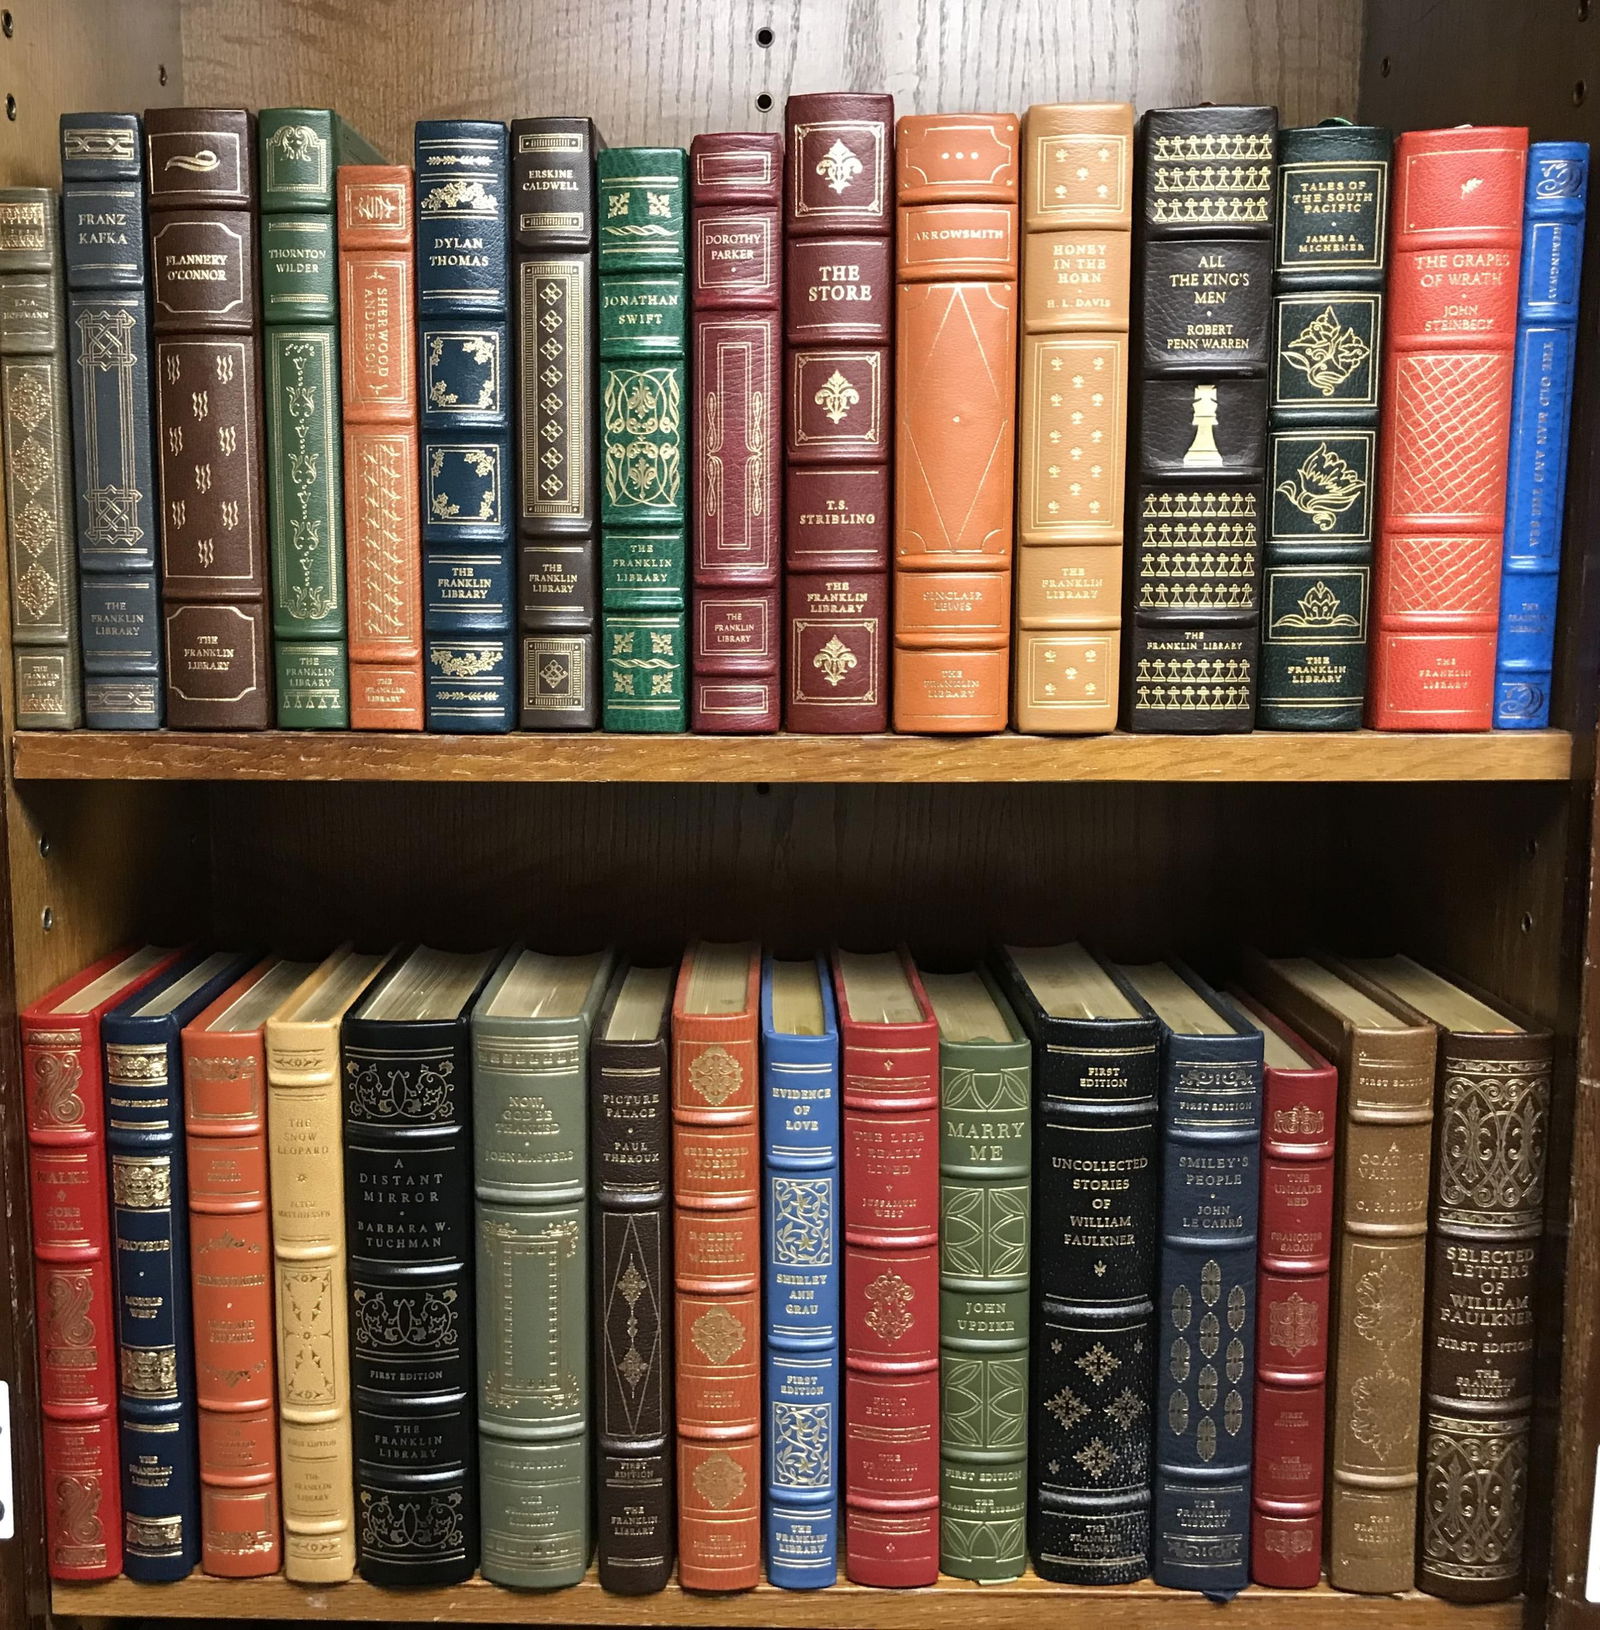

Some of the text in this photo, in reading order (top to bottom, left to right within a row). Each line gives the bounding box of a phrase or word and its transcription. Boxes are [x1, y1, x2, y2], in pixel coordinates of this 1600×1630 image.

[529, 170, 574, 179] ERSKINE
[522, 182, 579, 191] CALDWELL
[1300, 181, 1366, 192] TALES OF
[1292, 193, 1373, 204] THE SOUTH
[1304, 204, 1362, 214] PACIFIC
[78, 214, 126, 226] FRANZ
[79, 232, 128, 245] KAFKA
[705, 234, 762, 245] DOROTHY
[913, 229, 1003, 241] ARROWSMITH
[1306, 234, 1359, 244] JAMES A.
[434, 238, 483, 249] DYLAN
[1298, 243, 1365, 253] MICHENER
[268, 248, 326, 260] THORNTON
[711, 250, 754, 260] PARKER
[1053, 244, 1107, 256] HONEY
[166, 255, 228, 266] FLANNERY
[429, 256, 489, 267] THOMAS
[1053, 259, 1107, 269] IN THE
[1198, 256, 1225, 268] ALL
[1414, 253, 1510, 270] THE GRAPES
[276, 262, 319, 274] WILDER
[819, 265, 860, 281] THE
[168, 270, 227, 281] O'CONNOR
[1058, 273, 1102, 284] HORN
[1169, 273, 1250, 287] THE KING'S
[1420, 272, 1504, 287] OF WRATH
[808, 285, 872, 301] STORE
[1194, 291, 1226, 304] MEN
[604, 294, 678, 309] JONATHAN
[1062, 298, 1111, 308] L. DAVIS
[1443, 305, 1479, 318] JOHN
[618, 314, 663, 324] SWIFT
[1187, 324, 1233, 336] ROBERT
[1424, 318, 1495, 332] STEINBECK
[377, 287, 388, 377] SHERWOOD
[1167, 338, 1250, 349] PENN WARREN
[826, 500, 848, 511] T.S.
[799, 514, 876, 525] STRIBLING
[631, 545, 654, 553] THE
[543, 564, 562, 572] THE
[613, 559, 672, 567] FRANKLIN
[452, 568, 474, 577] THE
[616, 573, 668, 582] LIBRARY
[1060, 568, 1085, 577] THE
[438, 578, 492, 588] FRANKLIN
[529, 574, 578, 583] FRANKLIN
[1042, 579, 1103, 588] FRANKLIN
[532, 584, 574, 594] LIBRARY
[826, 582, 850, 591] THE
[441, 590, 488, 599] LIBRARY
[807, 593, 868, 602] FRANKLIN
[923, 591, 983, 601] SINCLAIR
[1046, 590, 1099, 600] LIBRARY
[105, 602, 127, 611] THE
[810, 604, 864, 613] LIBRARY
[91, 614, 144, 623] FRANKLIN
[727, 613, 742, 621] THE
[95, 627, 140, 635] LIBRARY
[714, 624, 754, 632] FRANKLIN
[197, 636, 218, 644] THE
[717, 635, 752, 643] LIBRARY
[1184, 632, 1204, 640] THE
[1146, 642, 1243, 650] FRANKLIN LIBRARY
[184, 649, 234, 658] FRANKLIN
[188, 661, 230, 670] LIBRARY
[299, 658, 320, 666] THE
[1306, 656, 1330, 665] THE
[286, 668, 335, 676] FRANKLIN
[1287, 666, 1346, 674] FRANKLIN
[289, 679, 331, 687] LIBRARY
[1292, 674, 1342, 683] LIBRARY
[1088, 1067, 1121, 1078] FIRST
[1079, 1078, 1128, 1088] EDITION
[772, 1088, 831, 1100] EVIDENCE
[602, 1094, 660, 1105] PICTURE
[794, 1105, 811, 1116] OF
[1180, 1102, 1252, 1112] FIRST EDITION
[606, 1108, 657, 1118] PALACE
[288, 1119, 312, 1128] THE
[785, 1120, 819, 1131] LOVE
[947, 1121, 1025, 1139] MARRY
[282, 1133, 317, 1141] SNOW
[277, 1146, 329, 1155] LEOPARD
[614, 1141, 648, 1151] PAUL
[1389, 1142, 1399, 1152] A
[603, 1153, 660, 1163] THEROUX
[970, 1145, 1004, 1161] ME
[394, 1158, 404, 1168] A
[1052, 1156, 1149, 1171] UNCOLLECTED
[1178, 1156, 1249, 1169] SMILEY'S
[359, 1173, 443, 1185] DISTANT
[1186, 1174, 1242, 1185] PEOPLE
[1072, 1178, 1130, 1191] STORIES
[364, 1191, 440, 1203] MIRROR
[1092, 1198, 1112, 1210] OF
[1197, 1205, 1231, 1215] JOHN
[1070, 1215, 1132, 1228] WILLIAM
[1182, 1216, 1244, 1228] LE CARRÉ
[357, 1221, 451, 1233] BARBARA W.
[366, 1237, 441, 1248] TUCHMAN
[1064, 1234, 1136, 1247] FAULKNER
[1446, 1246, 1535, 1263] SELECTED
[1452, 1263, 1529, 1278] LETTERS
[776, 1274, 828, 1286] SHIRLEY
[1480, 1282, 1505, 1295] OF
[789, 1290, 815, 1300] ANN
[1450, 1294, 1529, 1310] WILLIAM
[785, 1304, 819, 1315] GRAU
[966, 1302, 1006, 1315] JOHN
[1440, 1308, 1533, 1326] FAULKNER
[957, 1320, 1015, 1332] UPDIKE
[1436, 1336, 1533, 1353] FIRST EDITION
[370, 1370, 443, 1381] FIRST EDITION
[786, 1376, 818, 1385] FIRST
[780, 1386, 824, 1395] EDITION
[394, 1425, 420, 1434] THE
[375, 1435, 443, 1447] FRANKLIN
[379, 1449, 437, 1459] LIBRARY
[620, 1462, 649, 1470] FIRST
[614, 1471, 654, 1479] EDITION
[945, 1468, 1022, 1482] FIRST EDITION
[624, 1506, 644, 1515] THE
[610, 1516, 658, 1525] FRANKLIN
[614, 1527, 655, 1536] LIBRARY
